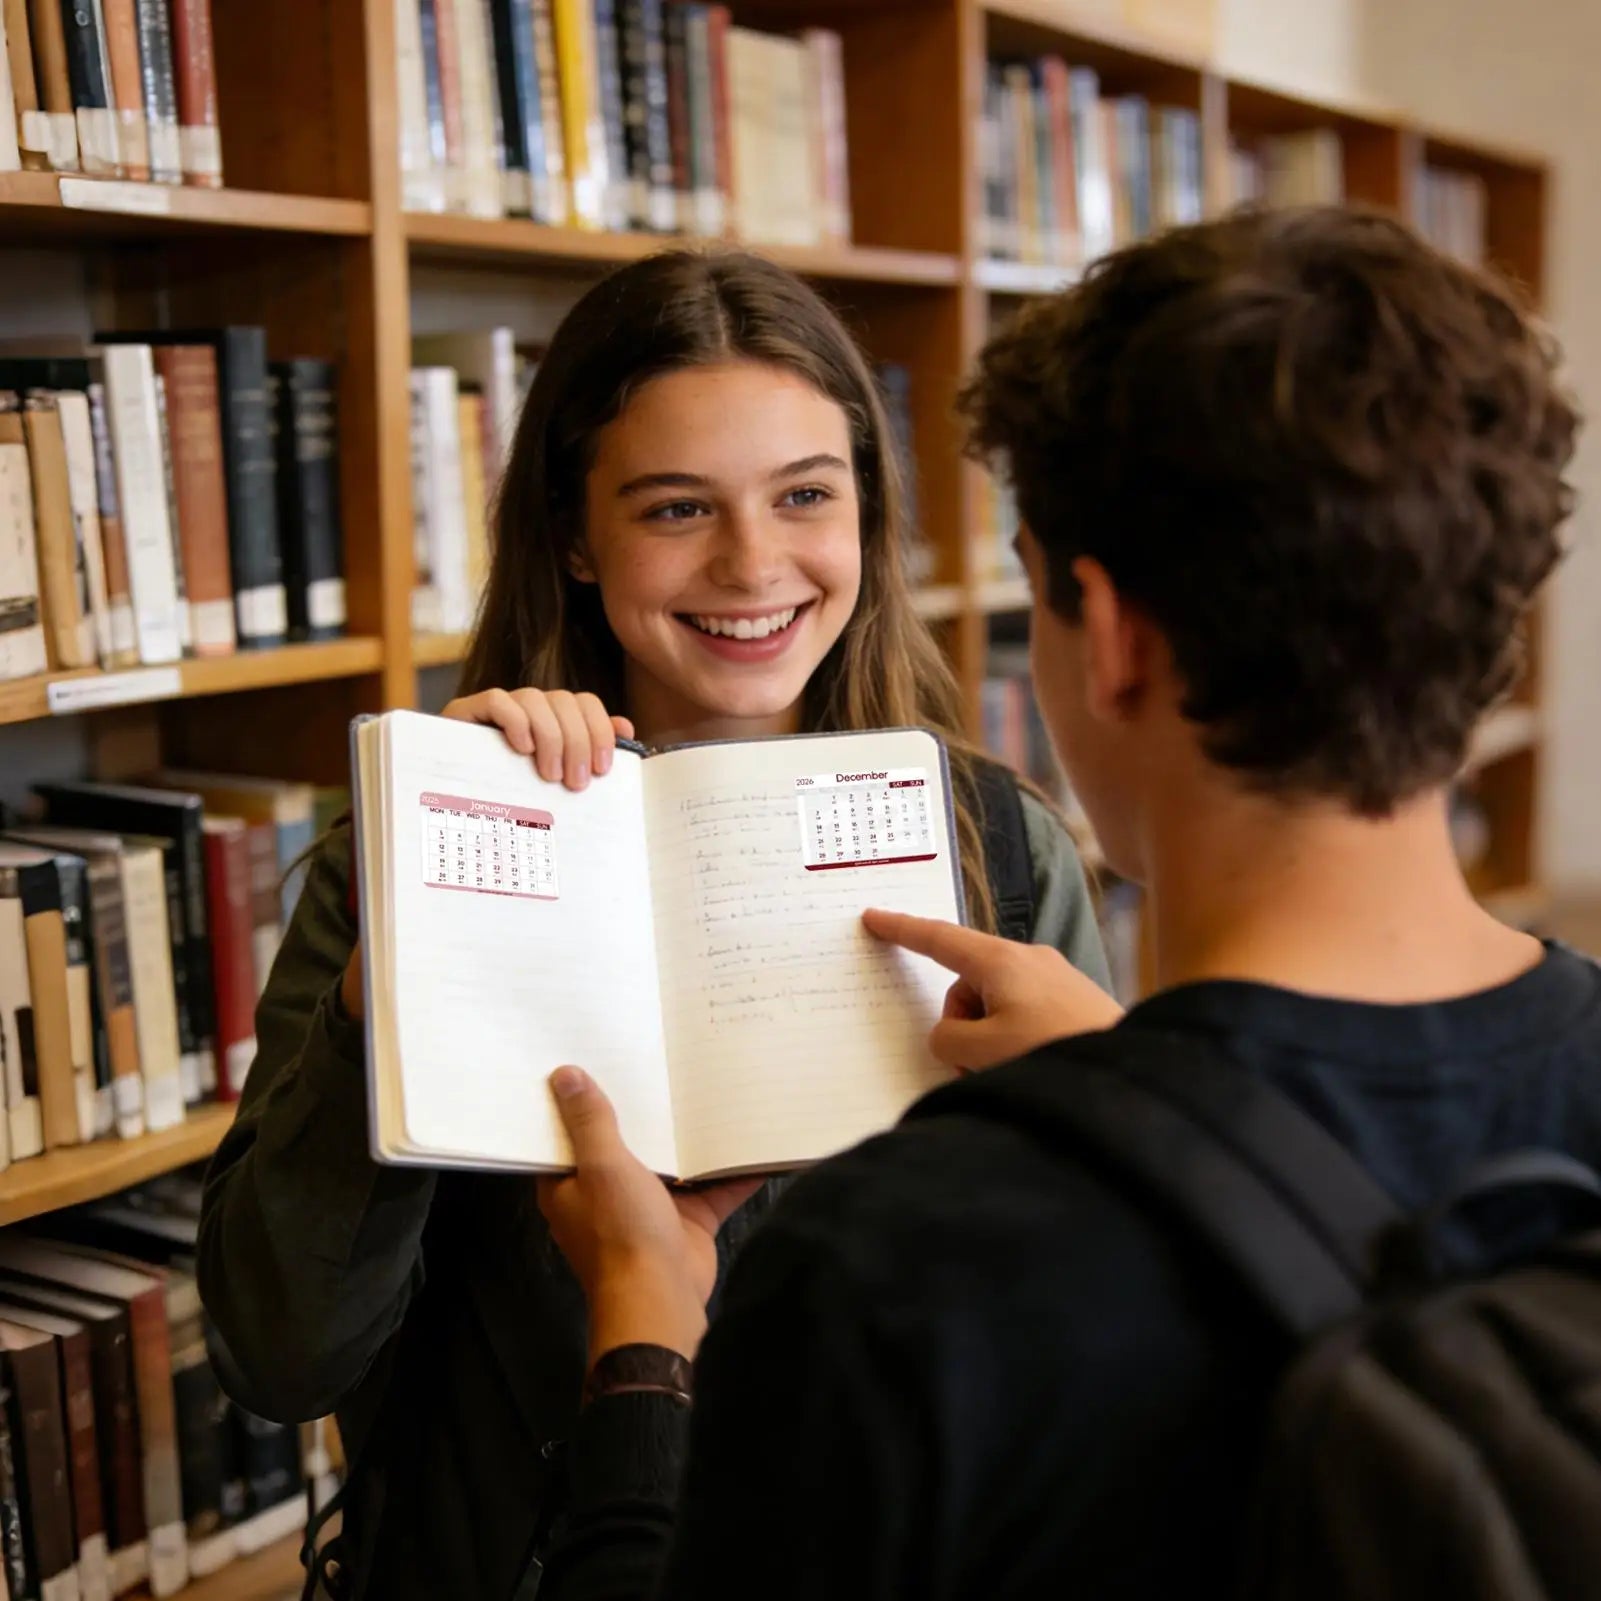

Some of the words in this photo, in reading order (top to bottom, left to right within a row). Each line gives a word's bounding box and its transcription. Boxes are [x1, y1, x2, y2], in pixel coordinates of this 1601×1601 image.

[796, 778, 814, 786] 2026
[836, 771, 888, 782] December
[470, 800, 511, 817] January
